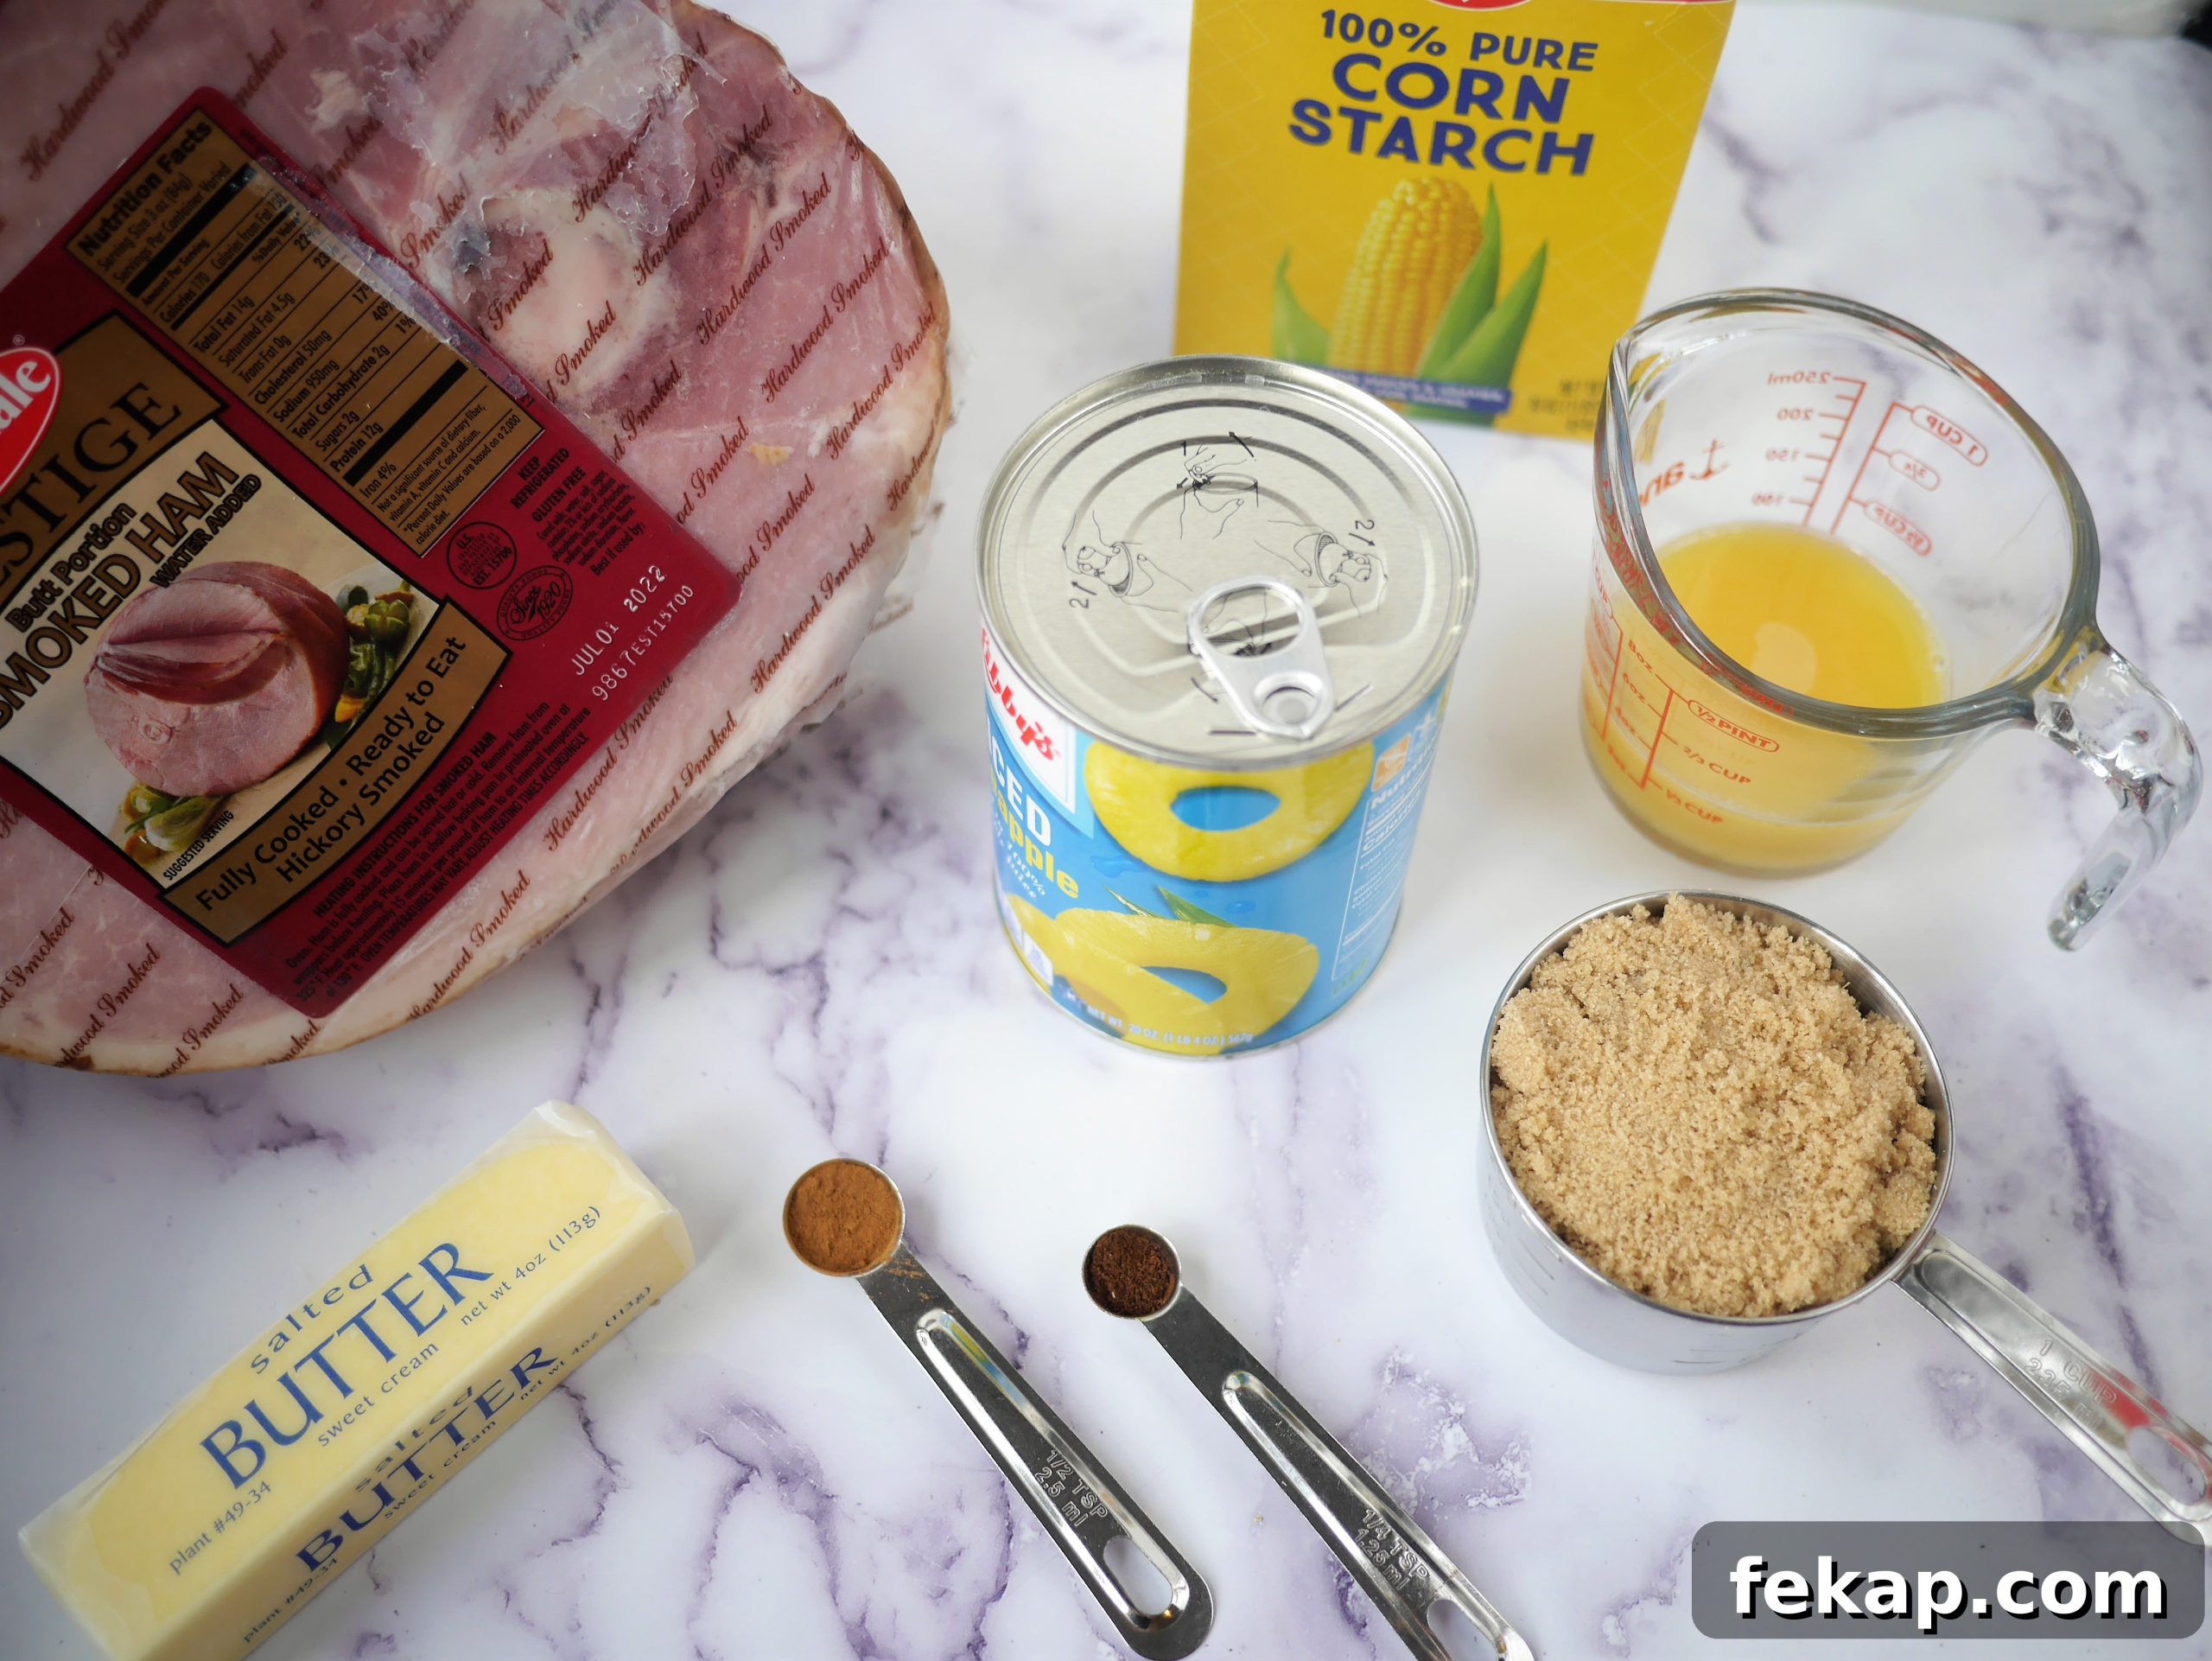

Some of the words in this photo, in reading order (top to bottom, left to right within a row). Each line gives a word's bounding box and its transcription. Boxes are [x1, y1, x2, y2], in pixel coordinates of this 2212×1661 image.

[1321, 10, 1446, 56] 100%
[1470, 32, 1599, 72] PURE
[1332, 53, 1569, 124] CORN
[1288, 98, 1594, 176] STARCH
[79, 174, 161, 255] Nutrition
[157, 123, 211, 173] Facts
[162, 192, 203, 232] Container
[770, 173, 832, 252] Smoked
[97, 237, 135, 271] Serving
[127, 217, 150, 239] Size
[211, 240, 244, 270] Calories
[255, 208, 272, 224] Fat
[160, 290, 195, 322] Calories
[190, 271, 210, 289] 170
[486, 239, 554, 332] Smoked
[760, 311, 833, 403] Hardwood
[830, 237, 890, 312] Smoked
[193, 326, 221, 353] Total
[216, 311, 236, 329] Fat
[232, 296, 255, 313] 14g
[219, 323, 261, 366] Saturated
[256, 310, 275, 328] Fat
[271, 293, 295, 312] 4.5g
[554, 300, 616, 387] Smoked
[238, 360, 264, 383] Trans
[258, 345, 278, 362] Fat
[254, 352, 307, 404] Cholesterol
[302, 330, 332, 356] 50mg
[273, 388, 310, 422] Sodium
[305, 360, 339, 388] 950mg
[292, 412, 319, 438] Total
[315, 357, 376, 415] Carbohydrate
[372, 343, 390, 359] 2g
[621, 360, 683, 442] Smoked
[315, 423, 346, 451] Sugars
[341, 410, 359, 424] 2g
[330, 438, 365, 472] Protein
[361, 422, 384, 439] 12g
[825, 372, 893, 461] Hardwood
[0, 381, 181, 589] STIGE
[359, 479, 381, 498] Iron
[377, 462, 397, 480] 4%
[394, 464, 424, 495] significant
[447, 418, 470, 441] dietary
[427, 493, 447, 511] Daily
[442, 474, 464, 493] Values
[470, 444, 491, 465] based
[500, 414, 520, 434] 2,000
[511, 449, 569, 508] REFRIGERATED
[518, 456, 540, 480] KEEP
[690, 416, 750, 498] Smoked
[124, 450, 239, 564] HAM
[150, 529, 212, 587] WATER
[206, 474, 261, 534] ADDED
[389, 498, 413, 521] vitamin
[417, 468, 442, 491] vitamin
[532, 487, 566, 521] GLUTEN
[563, 467, 585, 489] FREE
[755, 473, 816, 553] Smoked
[4, 579, 64, 633] Butt
[50, 503, 138, 586] Portion
[416, 524, 436, 544] calorie
[487, 546, 512, 570] 15700
[590, 557, 610, 575] Best
[614, 531, 633, 552] used
[503, 586, 548, 624] Since
[529, 582, 569, 620] 1920
[624, 565, 664, 611] 2022
[750, 601, 822, 694] Hardwood
[818, 529, 876, 601] Smoked
[1069, 597, 1089, 609] 2
[680, 710, 738, 787] Smoked
[1683, 746, 1706, 766] 2/3
[1707, 761, 1751, 786] CUP
[1718, 720, 1772, 749] PINT
[196, 862, 256, 910] Fully
[254, 786, 338, 863] Cooked
[346, 708, 414, 775] Ready
[405, 678, 434, 705] to
[426, 638, 466, 678] Eat
[276, 805, 364, 881] Hickory
[359, 713, 443, 805] Smoked
[544, 754, 618, 851] Hardwood
[163, 837, 205, 880] SUGGESTED
[200, 810, 233, 842] SERVING
[315, 877, 354, 916] HEATING
[353, 814, 417, 878] INSTRUCTIONS
[414, 793, 437, 815] FOR
[433, 756, 473, 796] SMOKED
[1685, 802, 1723, 824] CUP
[470, 869, 531, 947] Smoked
[4, 908, 75, 990] Smoked
[99, 944, 162, 1018] Smoked
[183, 984, 244, 1053] Smoked
[460, 1299, 488, 1327] net
[490, 1280, 512, 1300] wt
[515, 1253, 546, 1280] 4oz
[549, 1205, 602, 1252] (113g)
[251, 1263, 374, 1374] salted
[520, 1378, 543, 1401] net
[548, 1359, 567, 1376] wt
[571, 1333, 600, 1356] 4oz
[605, 1286, 652, 1327] (113g)
[200, 1243, 494, 1490] BUTTER
[318, 1398, 375, 1447] sweet
[380, 1341, 440, 1394] cream
[2040, 1340, 2054, 1357] 1
[2063, 1359, 2117, 1404] CUP
[296, 1346, 558, 1573] BUTTER
[355, 1385, 474, 1492] salted
[384, 1475, 435, 1519] sweet
[442, 1420, 497, 1467] cream
[1034, 1467, 1066, 1497] 2.5
[1061, 1500, 1089, 1527] ml
[1046, 1449, 1074, 1480] 1/2
[1071, 1478, 1109, 1518] TSP
[169, 1531, 213, 1575] plant
[213, 1480, 272, 1535] #49-34
[1355, 1528, 1391, 1567] 1.25
[1384, 1564, 1411, 1591] ml
[1362, 1509, 1393, 1540] 1/4
[1390, 1537, 1429, 1579] TSP
[243, 1606, 283, 1643] plant
[284, 1556, 338, 1605] #49-34
